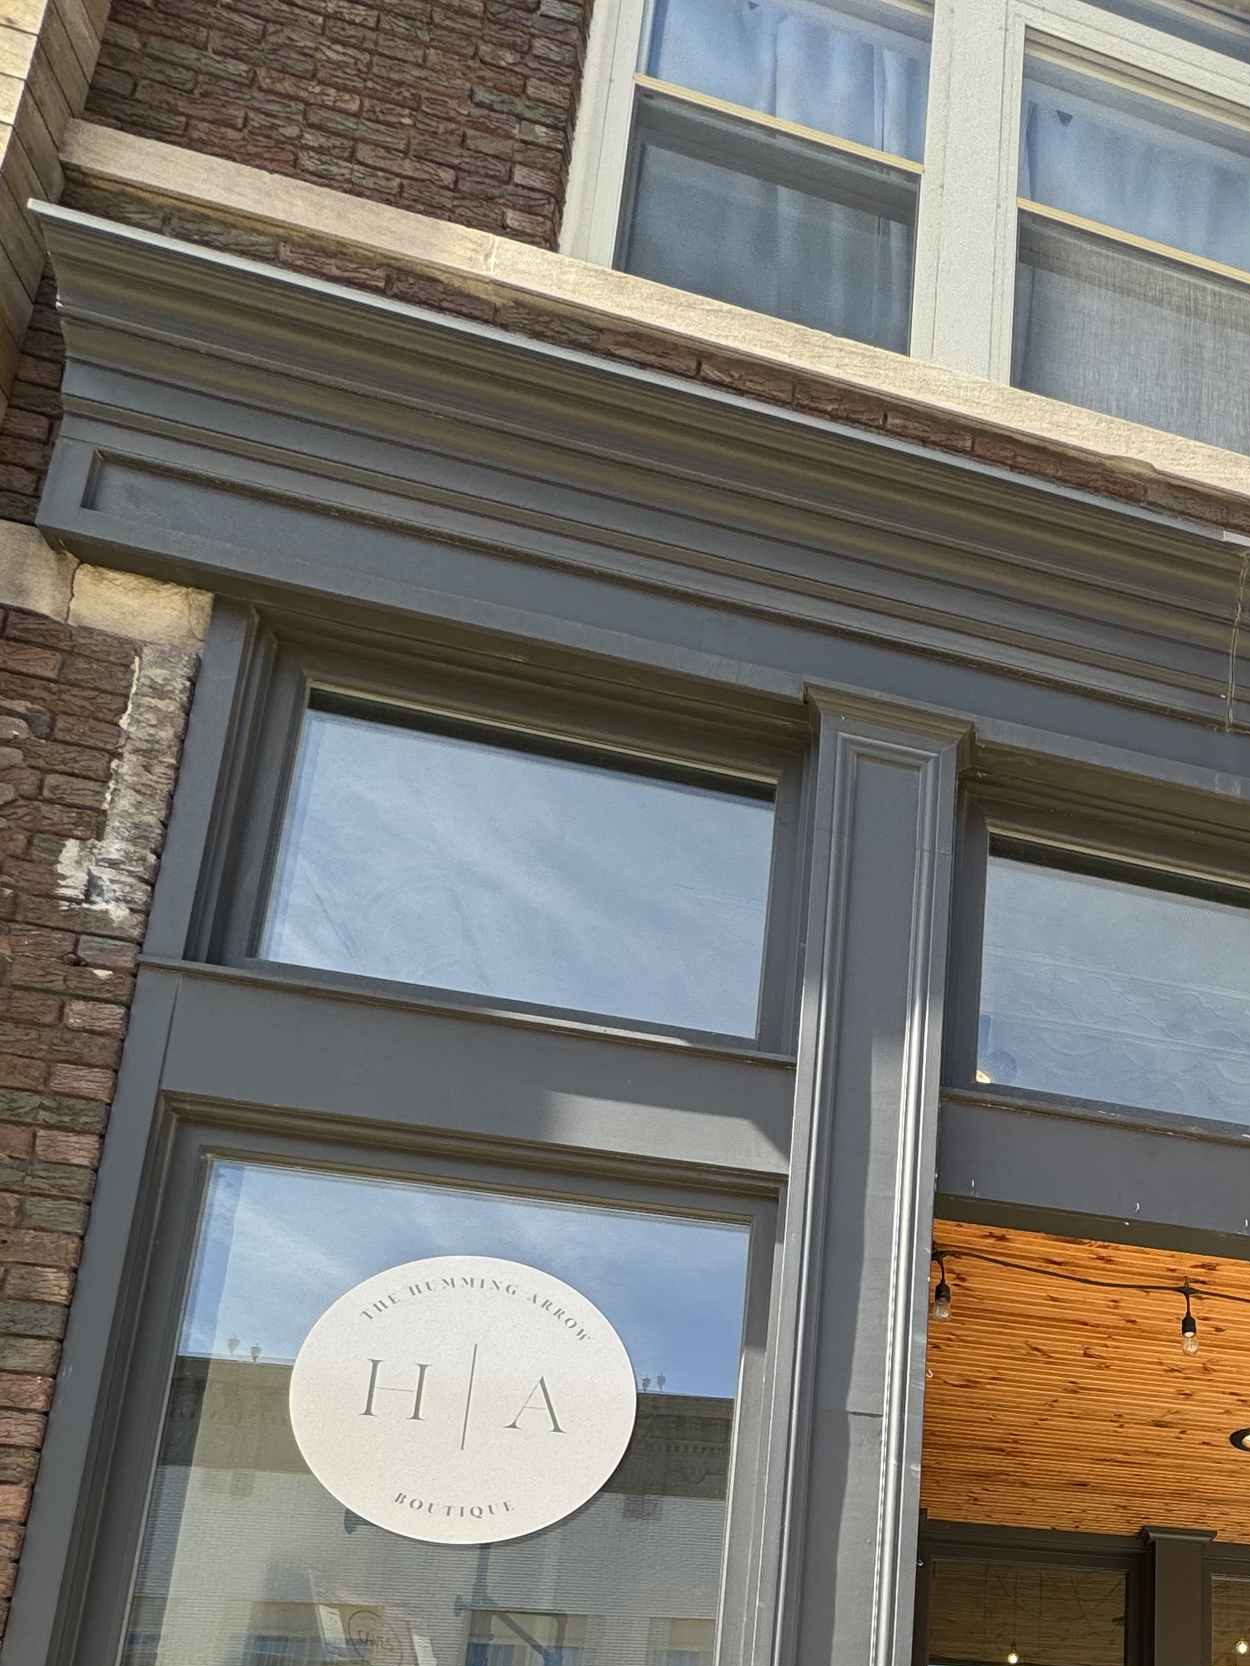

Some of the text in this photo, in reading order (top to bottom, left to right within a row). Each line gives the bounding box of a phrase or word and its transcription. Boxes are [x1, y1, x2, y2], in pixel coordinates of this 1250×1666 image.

[360, 1277, 592, 1341] THE HUMMING ARROW
[359, 1358, 567, 1434] H A
[394, 1491, 515, 1519] BOUTIQUE
